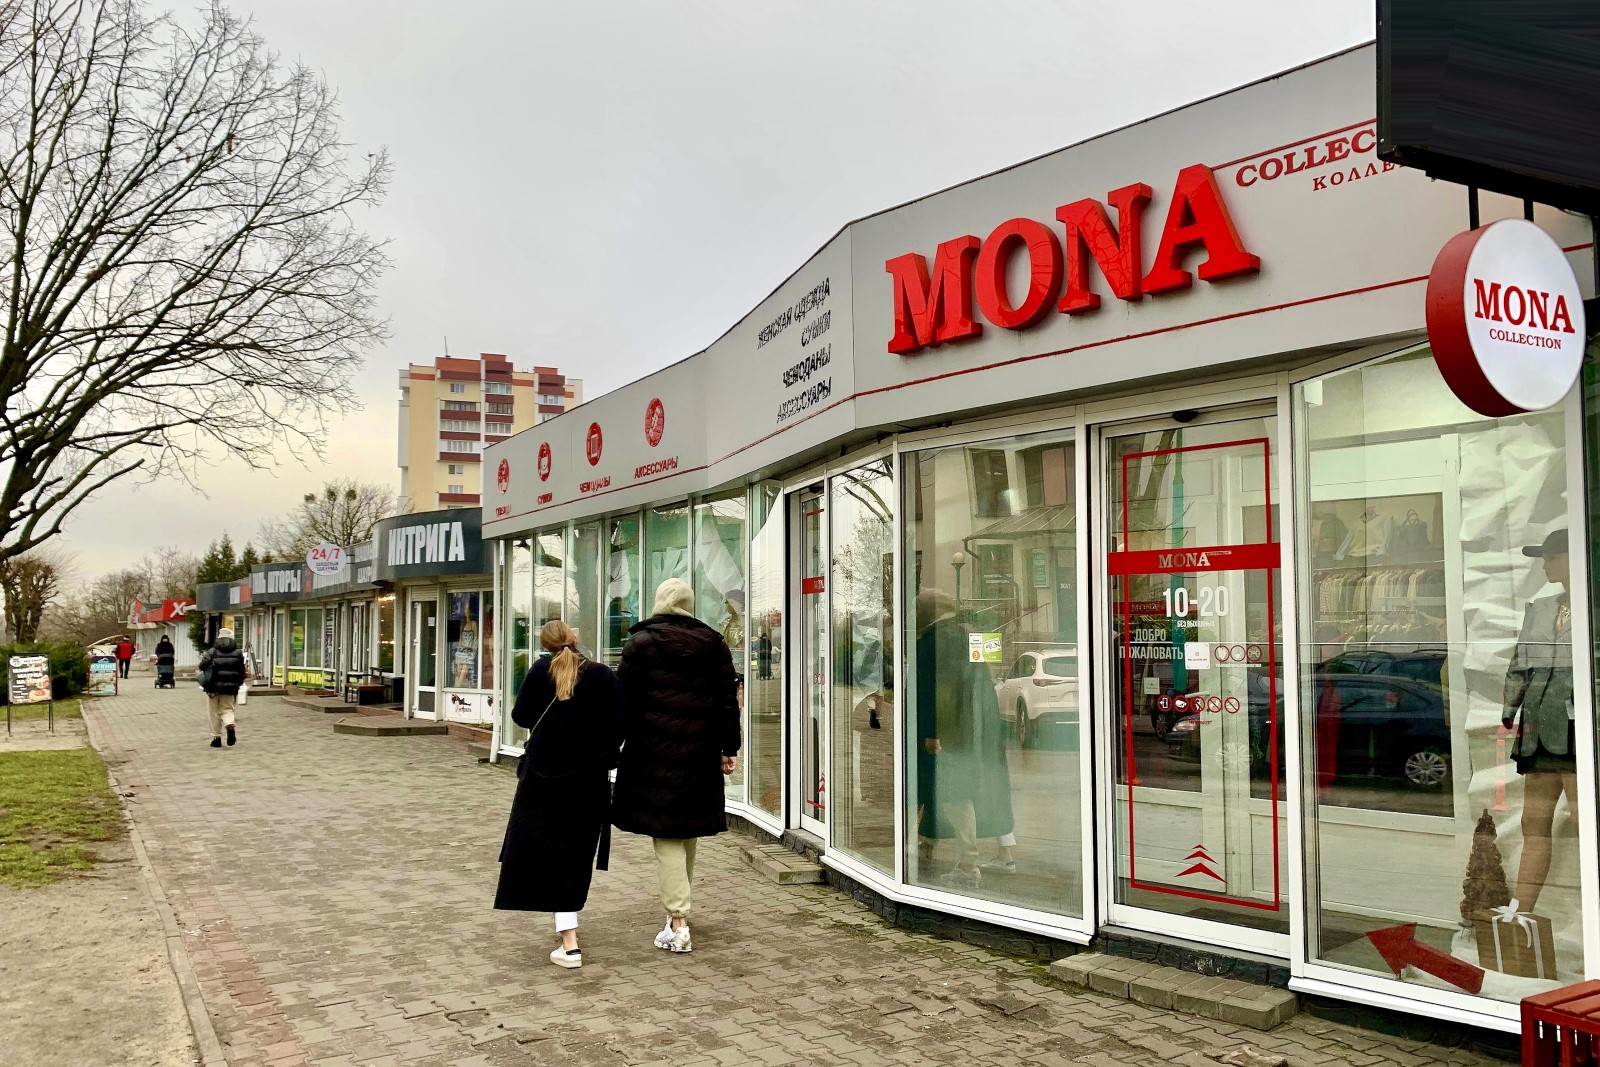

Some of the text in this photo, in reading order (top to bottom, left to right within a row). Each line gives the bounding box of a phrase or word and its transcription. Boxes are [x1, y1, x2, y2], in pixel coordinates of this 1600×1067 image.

[1312, 160, 1405, 191] КОЛЛЕ
[885, 162, 1261, 355] MONA
[1474, 278, 1575, 334] MONA
[1489, 328, 1562, 350] COLLECTION
[782, 343, 831, 388] ЧЕМОДАНЫ
[776, 376, 832, 423] АКСЕССУАРЫ
[634, 456, 679, 479] АКСЕССУАРЫ
[312, 547, 341, 561] 24/7
[388, 521, 465, 566] ИНТРИГА
[1158, 552, 1210, 569] MONA
[1163, 585, 1229, 618] 10-20
[1134, 628, 1167, 643] ДОБРО
[1177, 620, 1187, 628] БЕЗ
